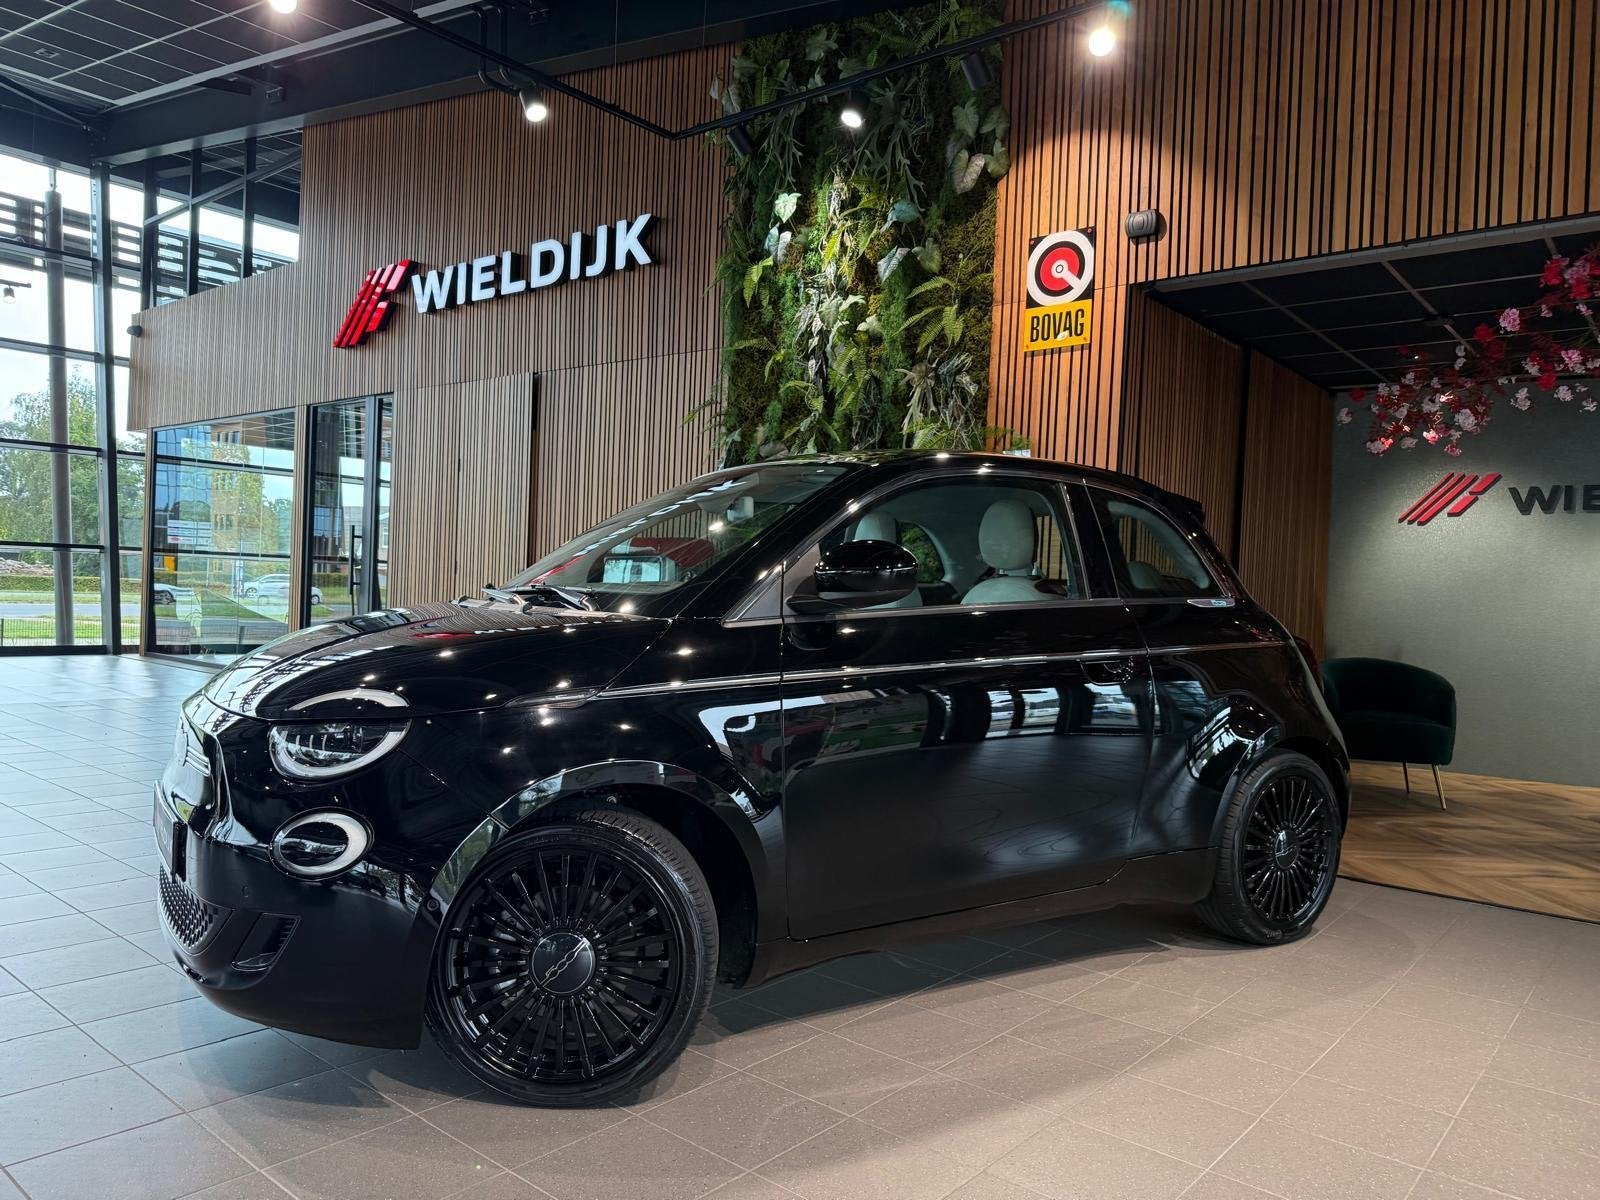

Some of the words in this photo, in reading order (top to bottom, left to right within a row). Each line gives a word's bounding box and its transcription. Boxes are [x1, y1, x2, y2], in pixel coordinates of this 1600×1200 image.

[411, 213, 652, 314] WIELDIJK
[1030, 308, 1085, 343] BOVAG
[1507, 484, 1600, 515] WIE
